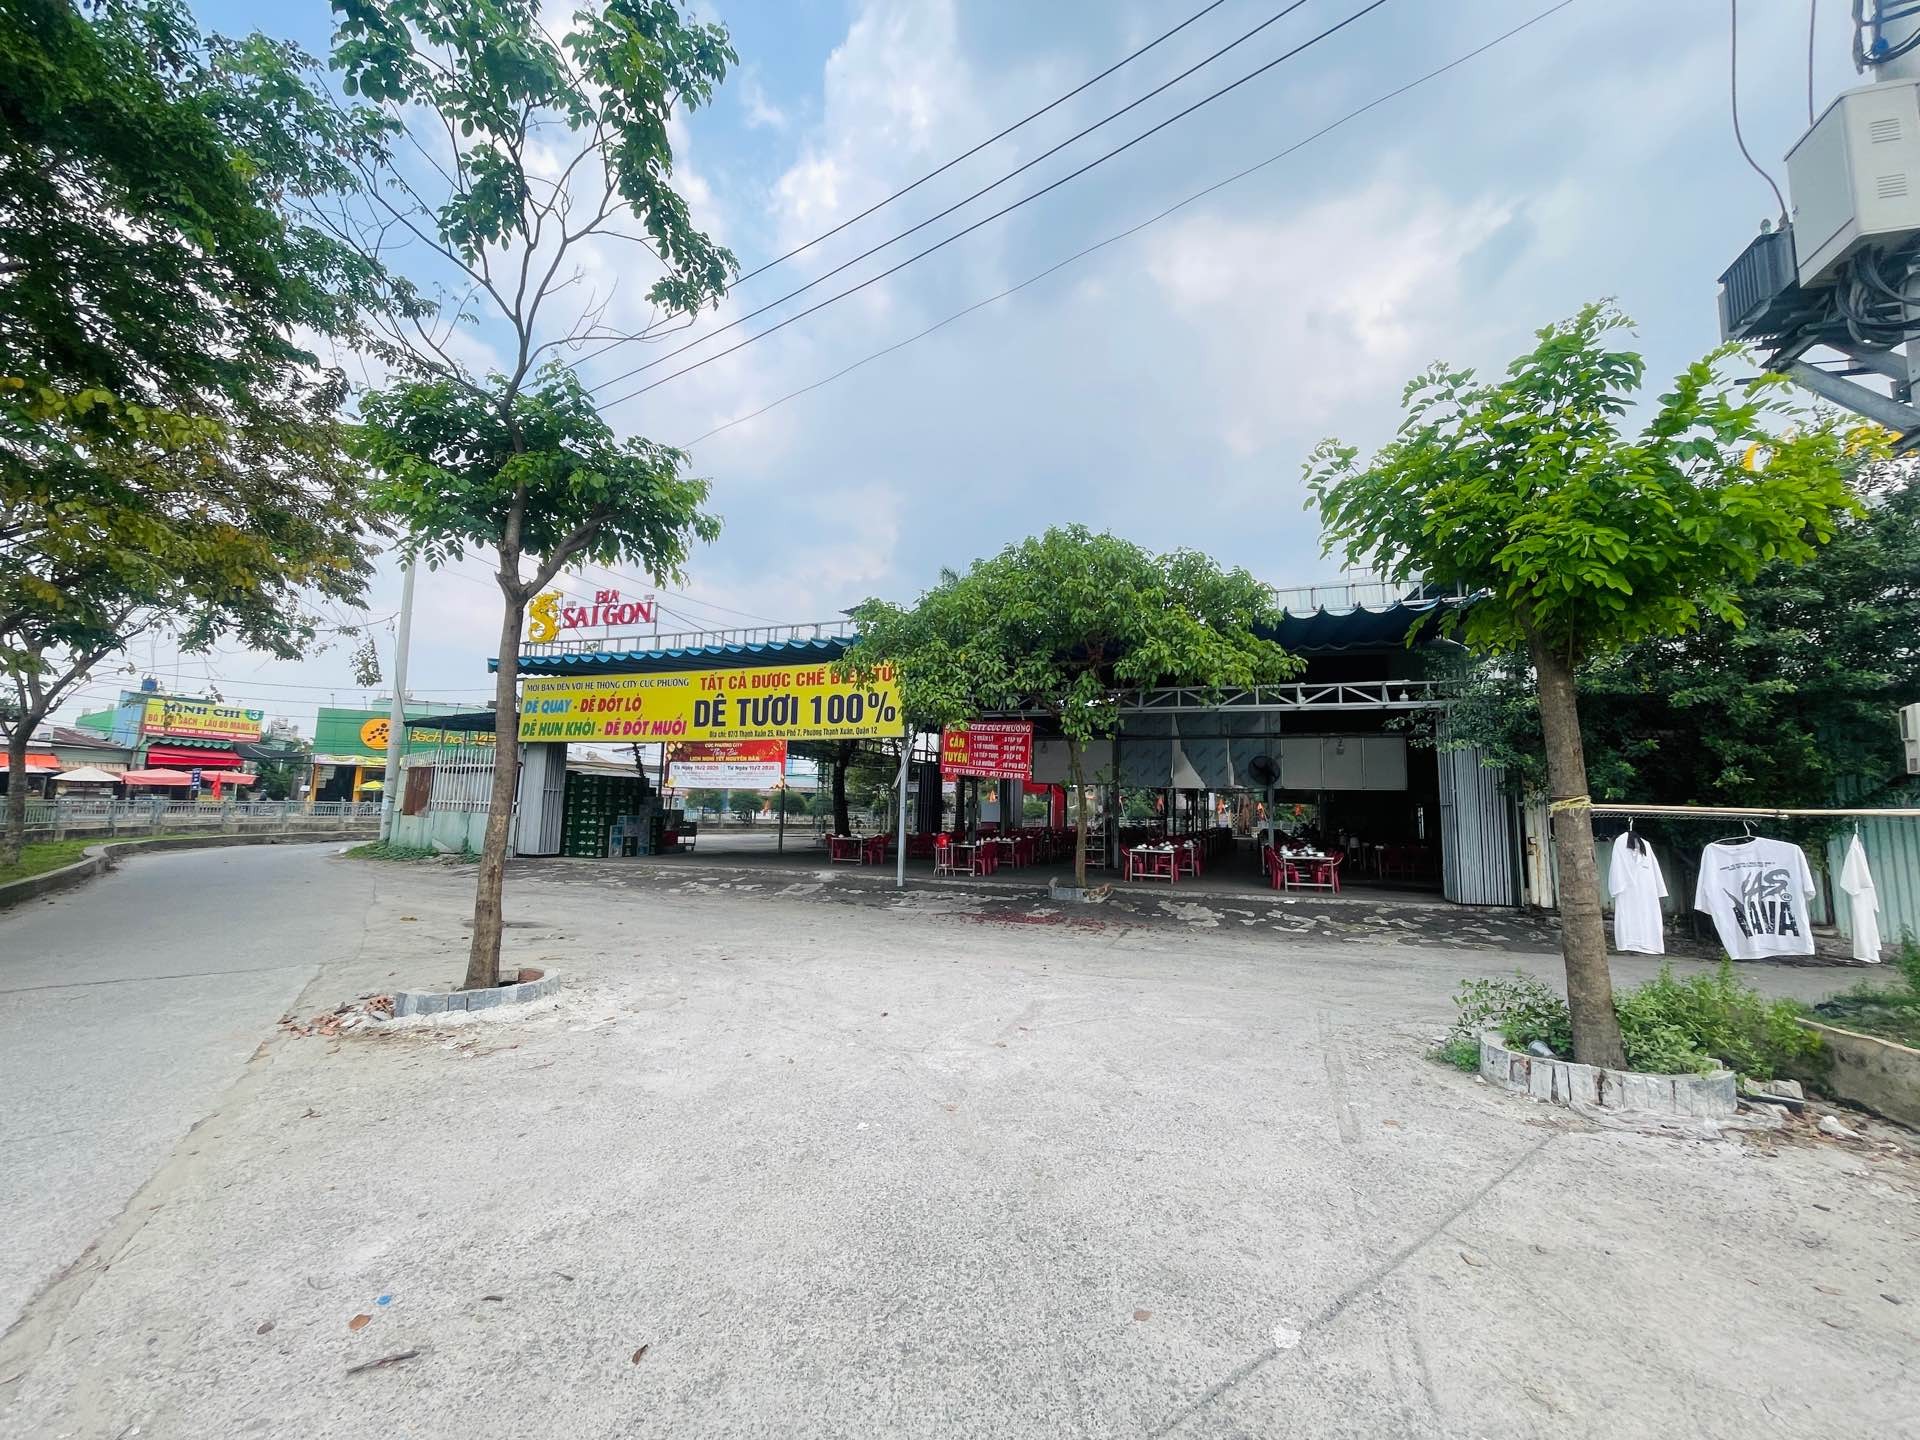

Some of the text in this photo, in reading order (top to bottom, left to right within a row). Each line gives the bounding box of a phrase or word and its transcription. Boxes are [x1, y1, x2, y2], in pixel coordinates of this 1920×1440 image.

[595, 589, 620, 604] BIA
[622, 680, 638, 689] CITY
[700, 671, 724, 690] TẤT
[728, 671, 747, 689] CẢ
[752, 671, 790, 690] ĐƯỢC
[796, 666, 826, 686] CHẾ
[541, 698, 572, 714] QUAY
[580, 695, 597, 712] DÊ
[693, 691, 896, 728] DÊ TƯƠI 100%
[522, 718, 537, 736] DÊ
[538, 721, 564, 736] HUN
[565, 716, 596, 736] KHÓI
[604, 717, 621, 736] DÊ
[651, 712, 687, 736] MUỐI
[871, 726, 878, 734] 12
